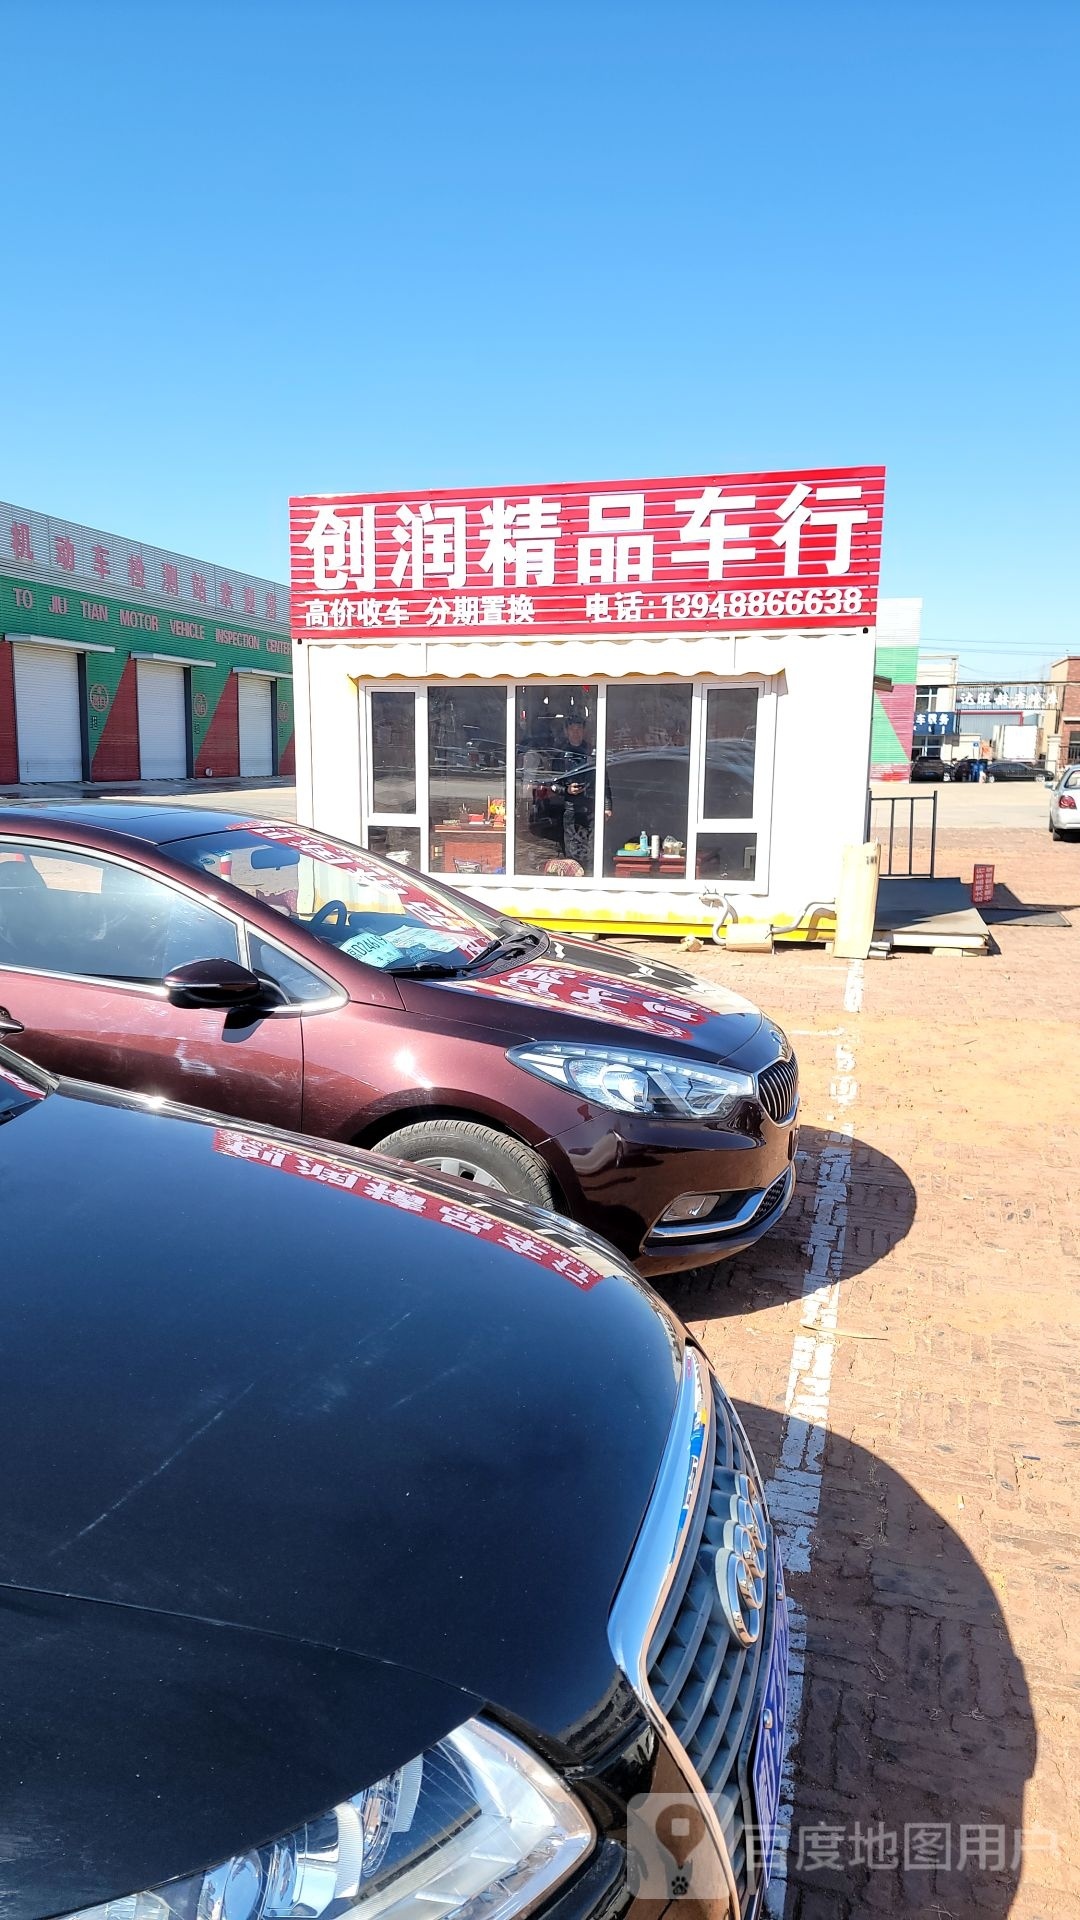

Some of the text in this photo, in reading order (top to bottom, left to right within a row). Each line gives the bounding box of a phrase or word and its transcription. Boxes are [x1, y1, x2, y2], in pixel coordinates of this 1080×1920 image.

[302, 482, 868, 590] 创润精品车行
[13, 587, 33, 609] TO
[80, 600, 108, 622] TIAN
[120, 608, 159, 631] MOTOR
[169, 618, 205, 640] VEHICLE
[215, 627, 260, 650] INSPECTION
[304, 597, 410, 627] 高价收车
[424, 593, 536, 626] 分期置换
